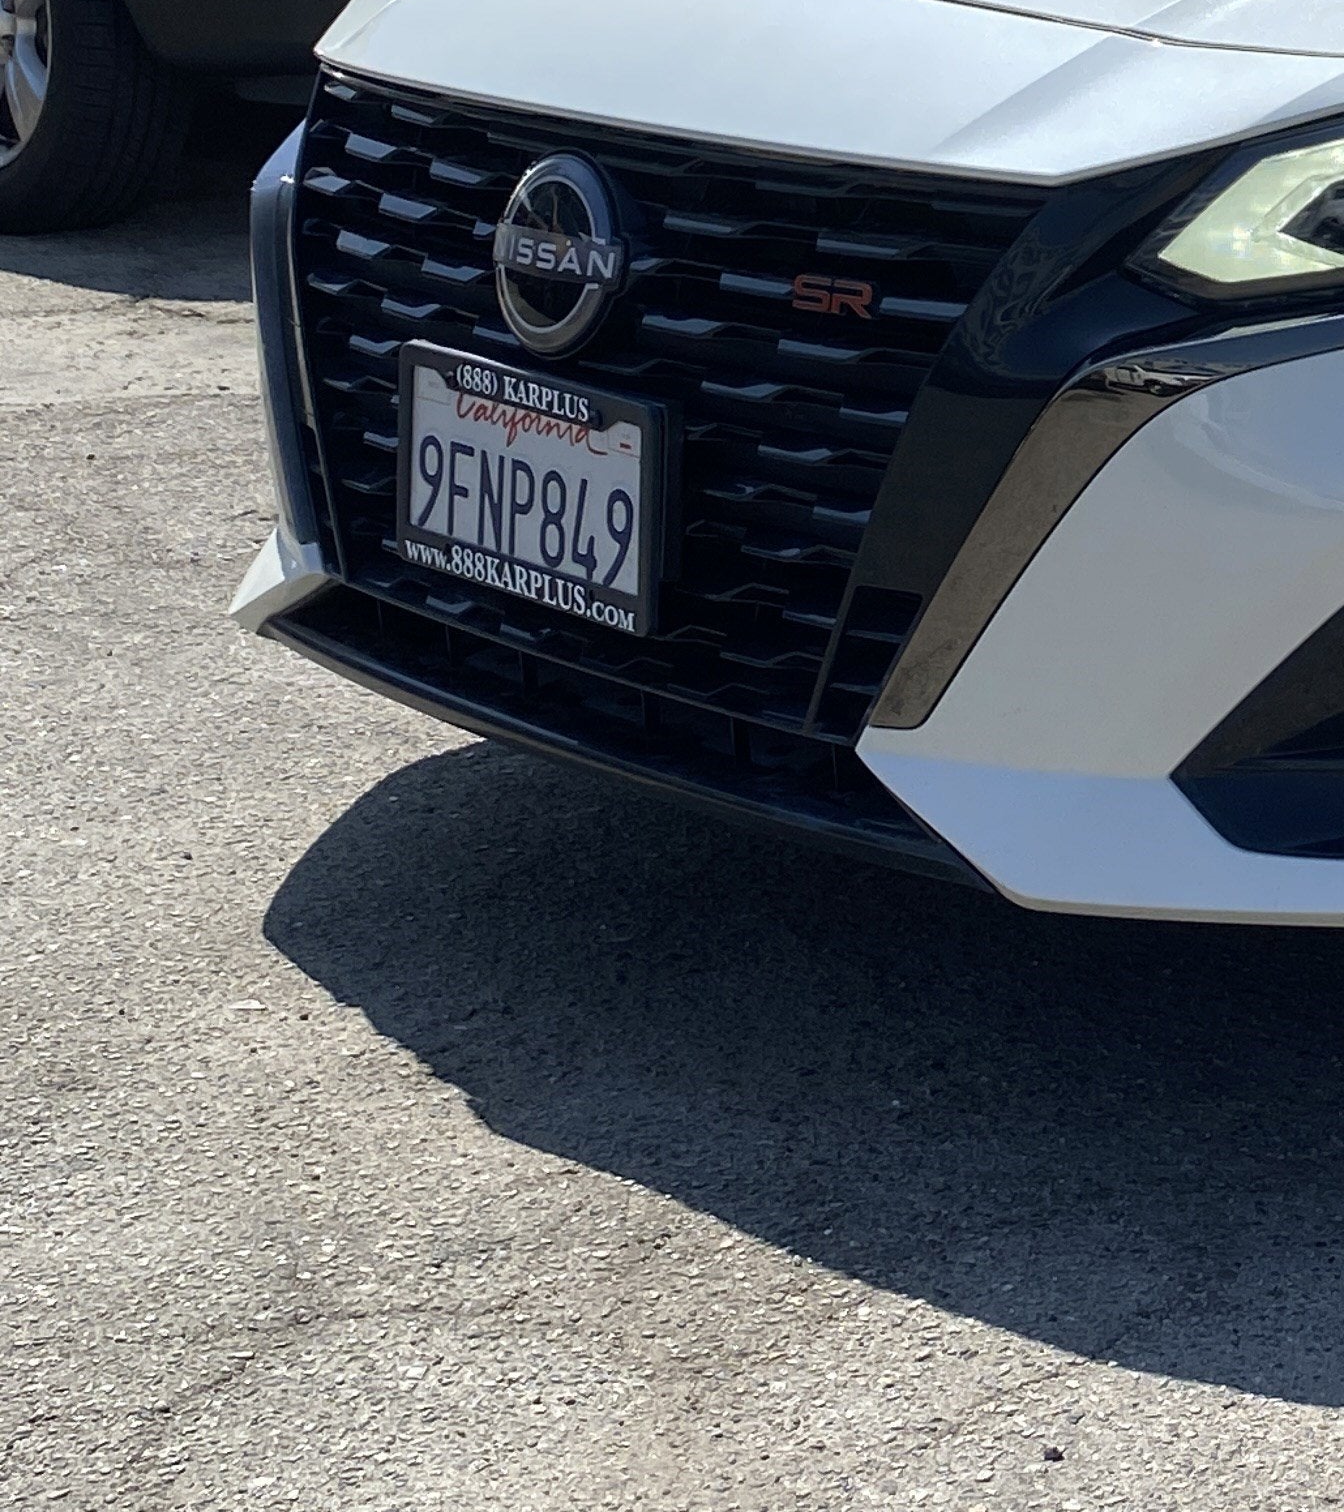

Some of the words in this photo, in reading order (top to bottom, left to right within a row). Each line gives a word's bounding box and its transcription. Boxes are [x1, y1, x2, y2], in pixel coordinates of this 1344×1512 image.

[494, 231, 616, 278] NISSAN
[792, 274, 873, 320] SR
[456, 364, 498, 396] (888)
[503, 376, 589, 422] KARPLUS
[456, 392, 608, 455] California
[419, 435, 634, 586] 9FNP849
[405, 540, 635, 633] www.888KARPLUS.COM
